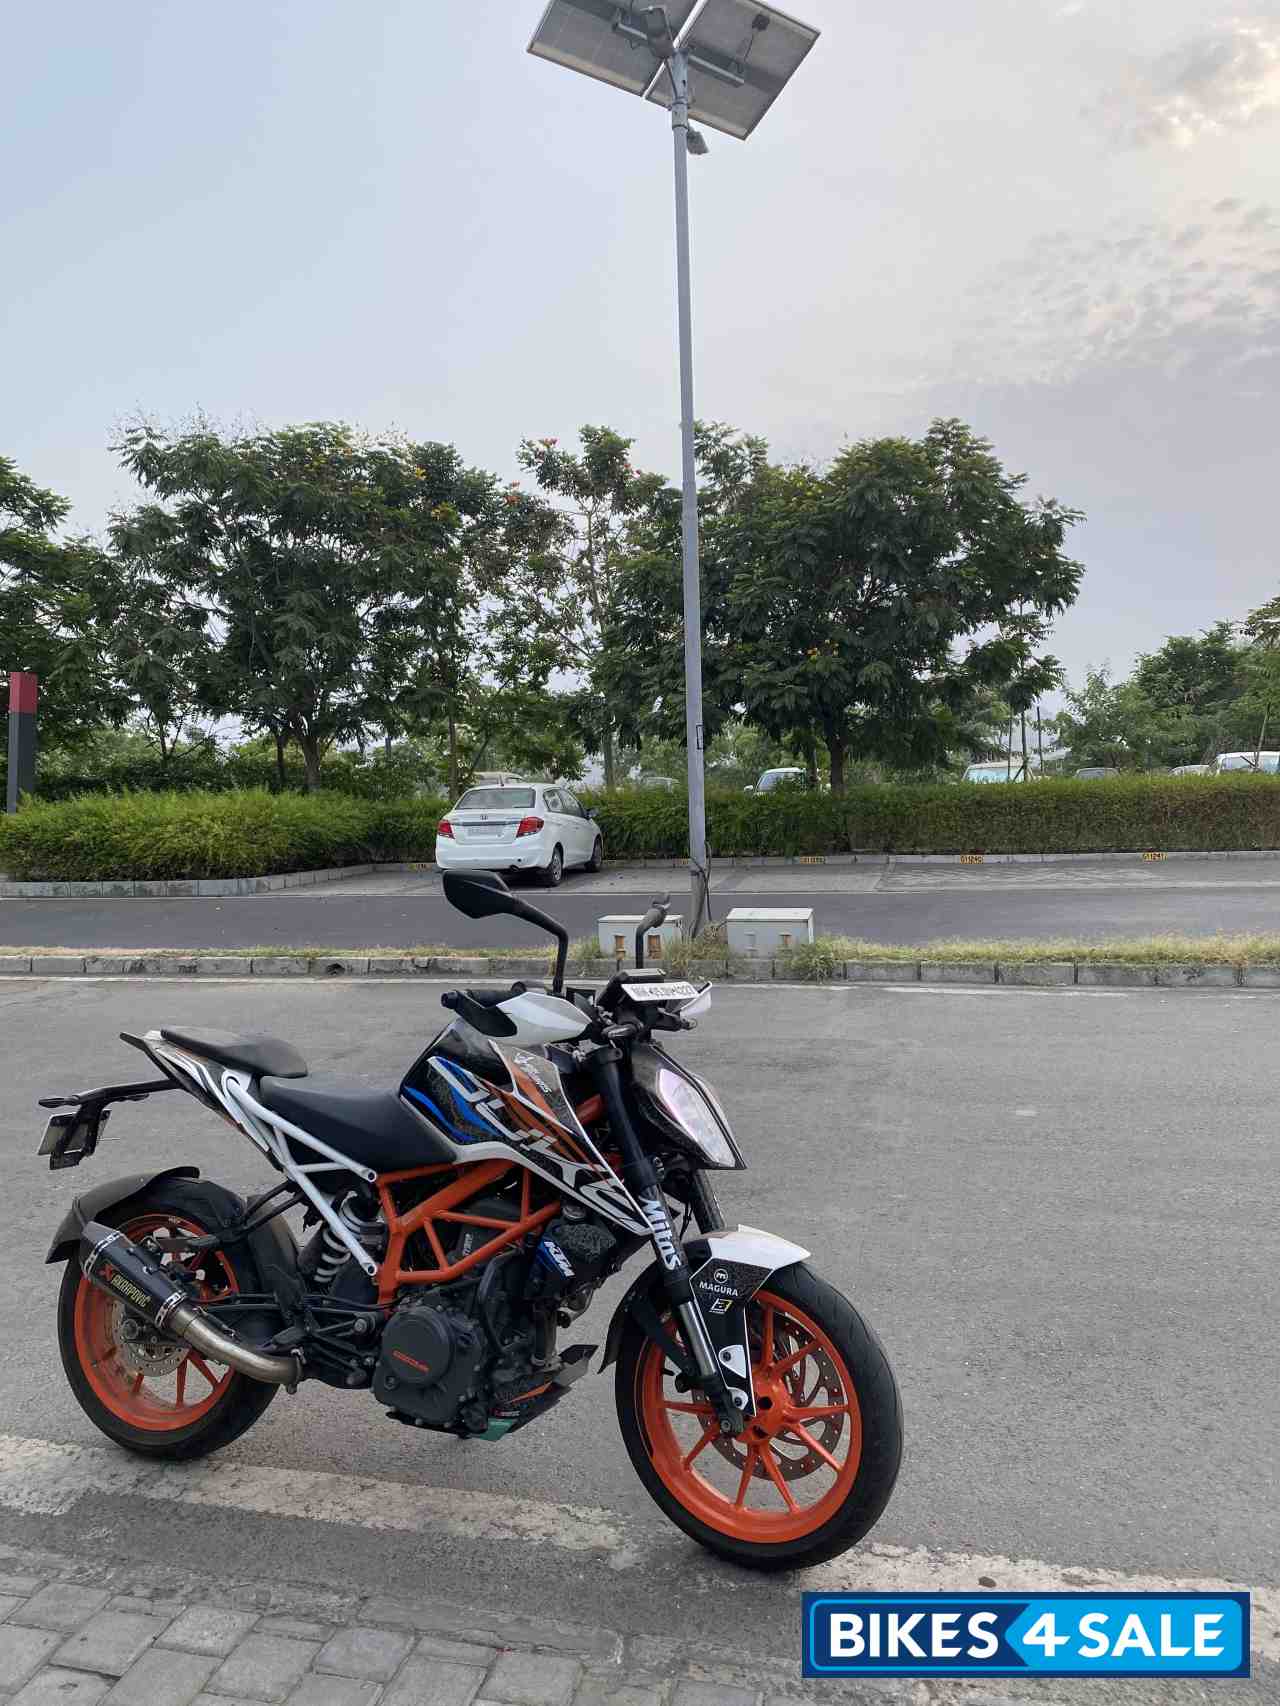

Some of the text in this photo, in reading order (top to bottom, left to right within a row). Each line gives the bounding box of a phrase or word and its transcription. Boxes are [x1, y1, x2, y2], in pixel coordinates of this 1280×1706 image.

[427, 1056, 650, 1235] DUKE
[544, 1241, 576, 1277] KTM
[699, 1280, 738, 1297] MAGURA
